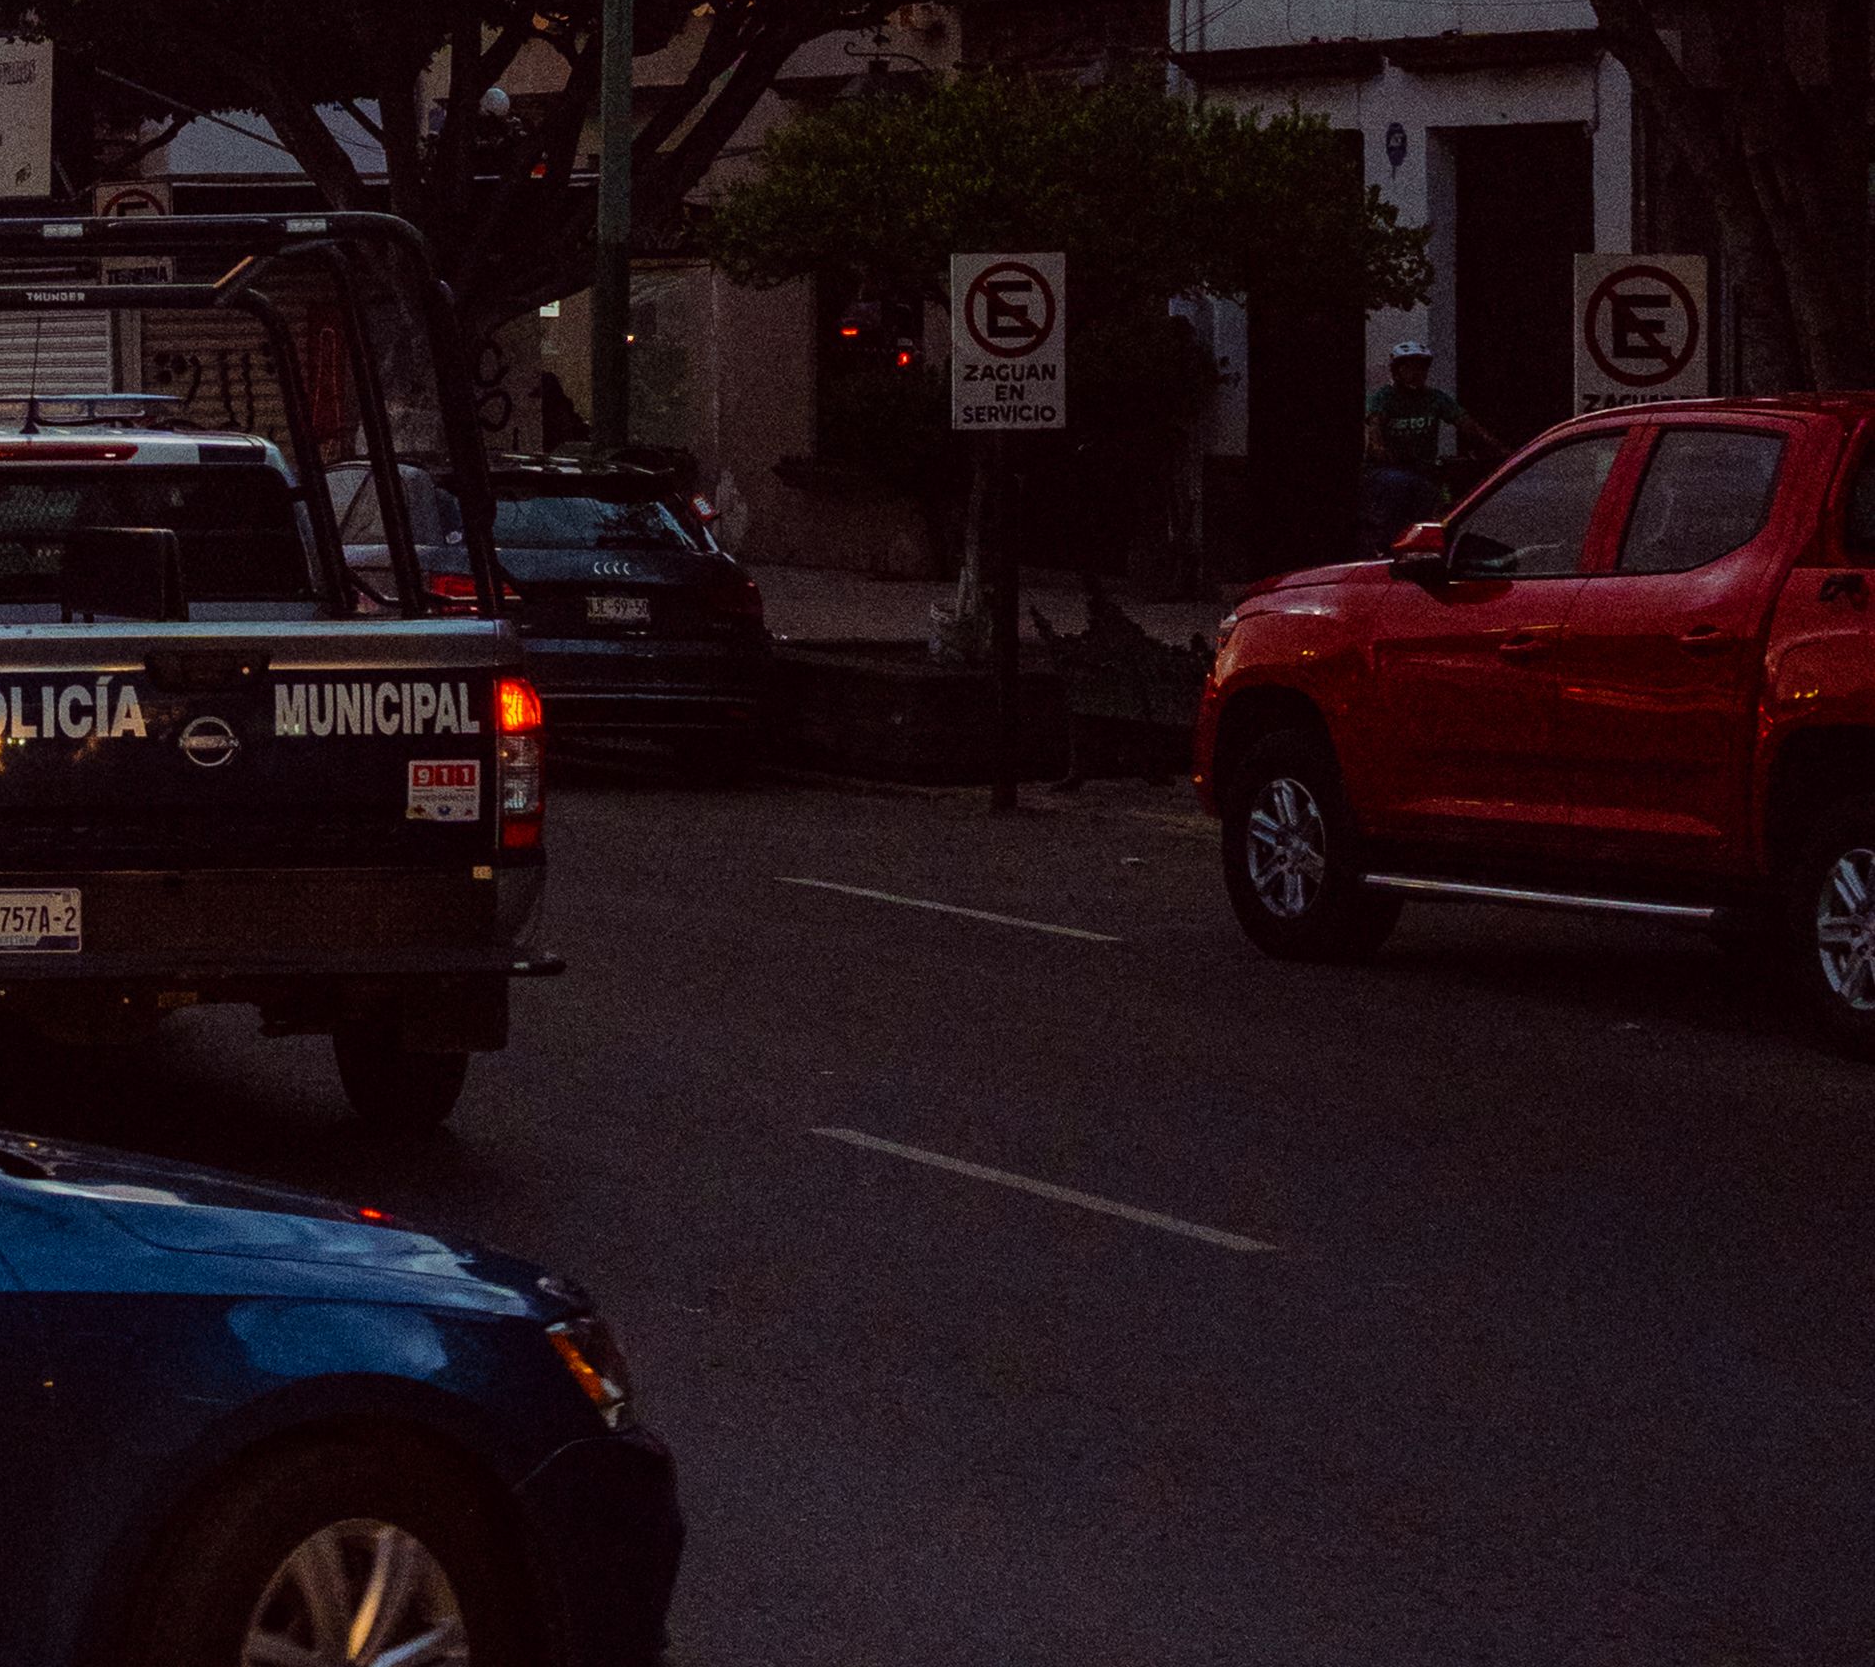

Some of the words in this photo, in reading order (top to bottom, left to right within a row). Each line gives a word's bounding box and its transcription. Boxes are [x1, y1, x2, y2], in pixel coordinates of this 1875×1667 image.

[26, 292, 86, 302] THUNDER
[963, 364, 1056, 382] ZAGUAN
[995, 384, 1025, 402] EN
[963, 405, 1057, 424] SERVICIO
[274, 681, 481, 738] MUNICIPAL
[417, 768, 470, 785] 911
